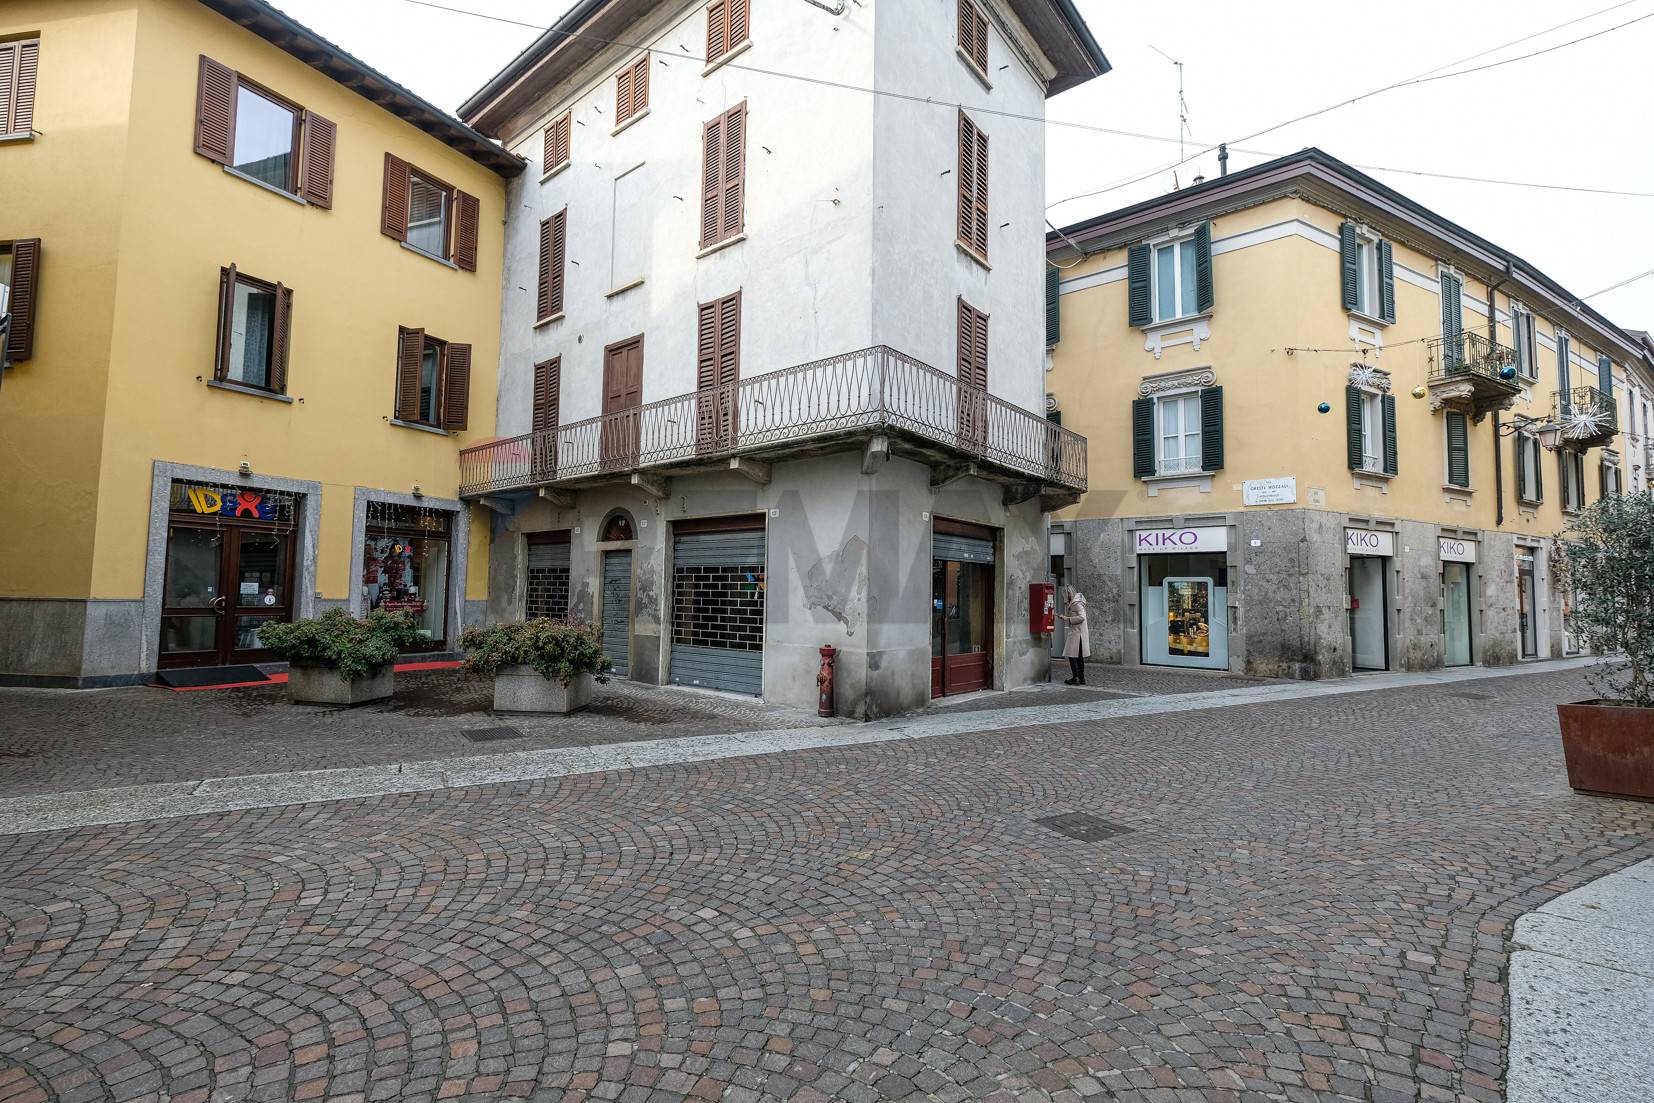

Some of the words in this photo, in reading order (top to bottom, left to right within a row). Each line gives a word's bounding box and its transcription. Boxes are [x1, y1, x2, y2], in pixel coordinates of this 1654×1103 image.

[1138, 531, 1198, 546] KIKO
[1346, 531, 1379, 548] KIKO
[1440, 541, 1465, 556] KIKO
